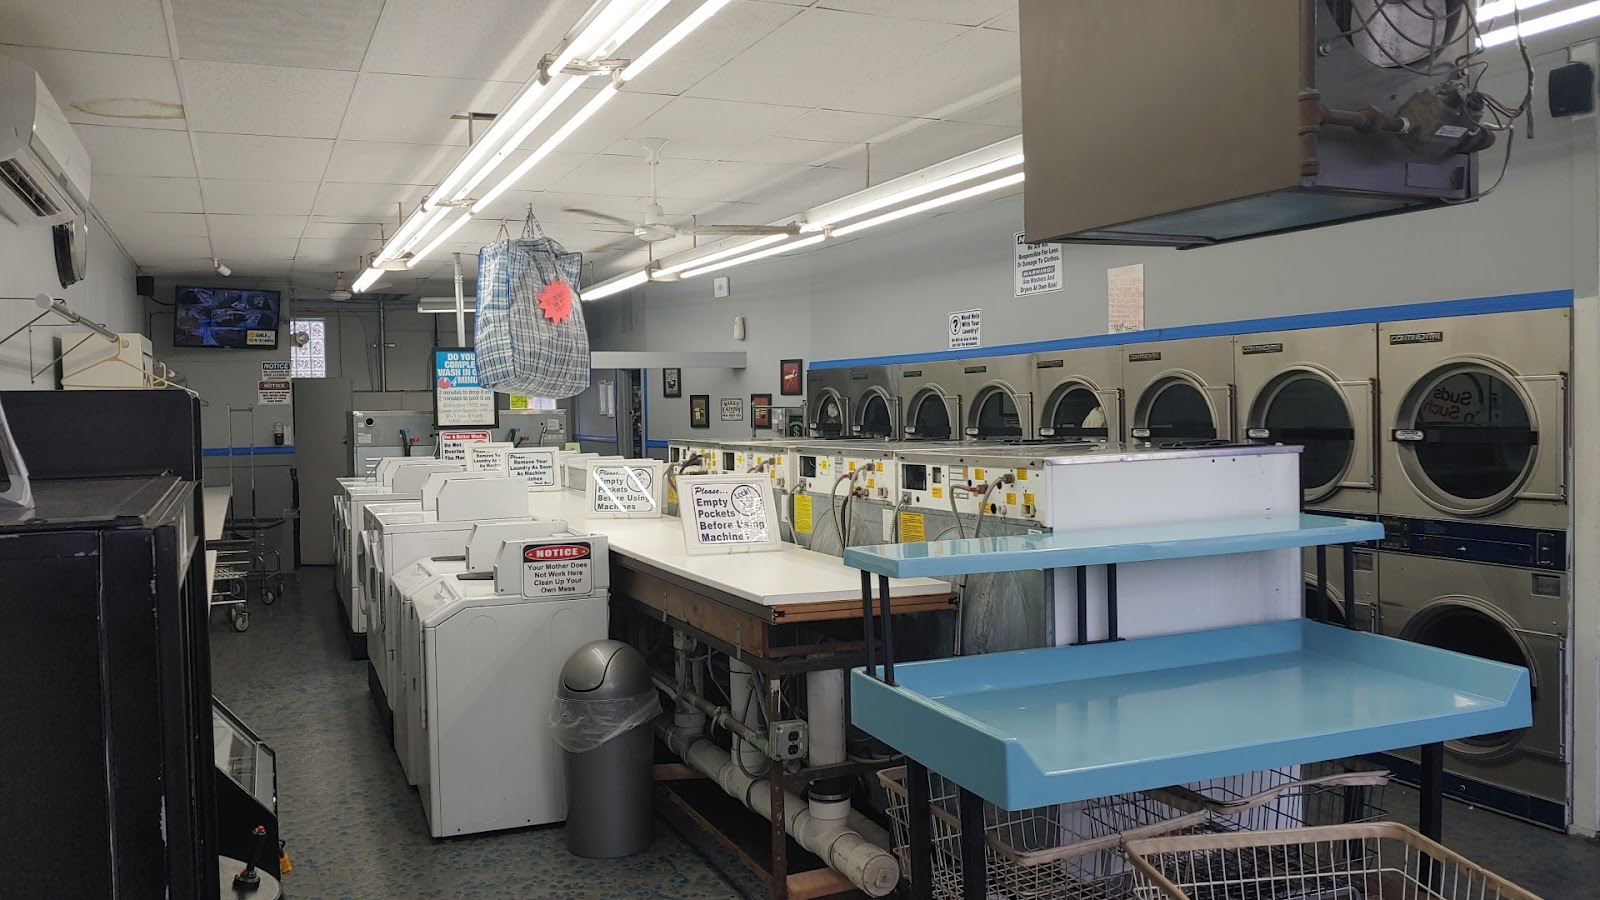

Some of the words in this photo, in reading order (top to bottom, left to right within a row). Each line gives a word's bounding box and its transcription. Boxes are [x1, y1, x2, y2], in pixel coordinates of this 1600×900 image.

[1019, 251, 1040, 260] Responsible
[438, 368, 460, 376] WASH
[451, 377, 457, 387] 4
[694, 487, 728, 495] Please...
[627, 494, 650, 502] Using
[696, 498, 728, 508] Empty
[698, 509, 736, 518] Pockets
[700, 521, 733, 530] Before
[536, 548, 578, 558] NOTICE
